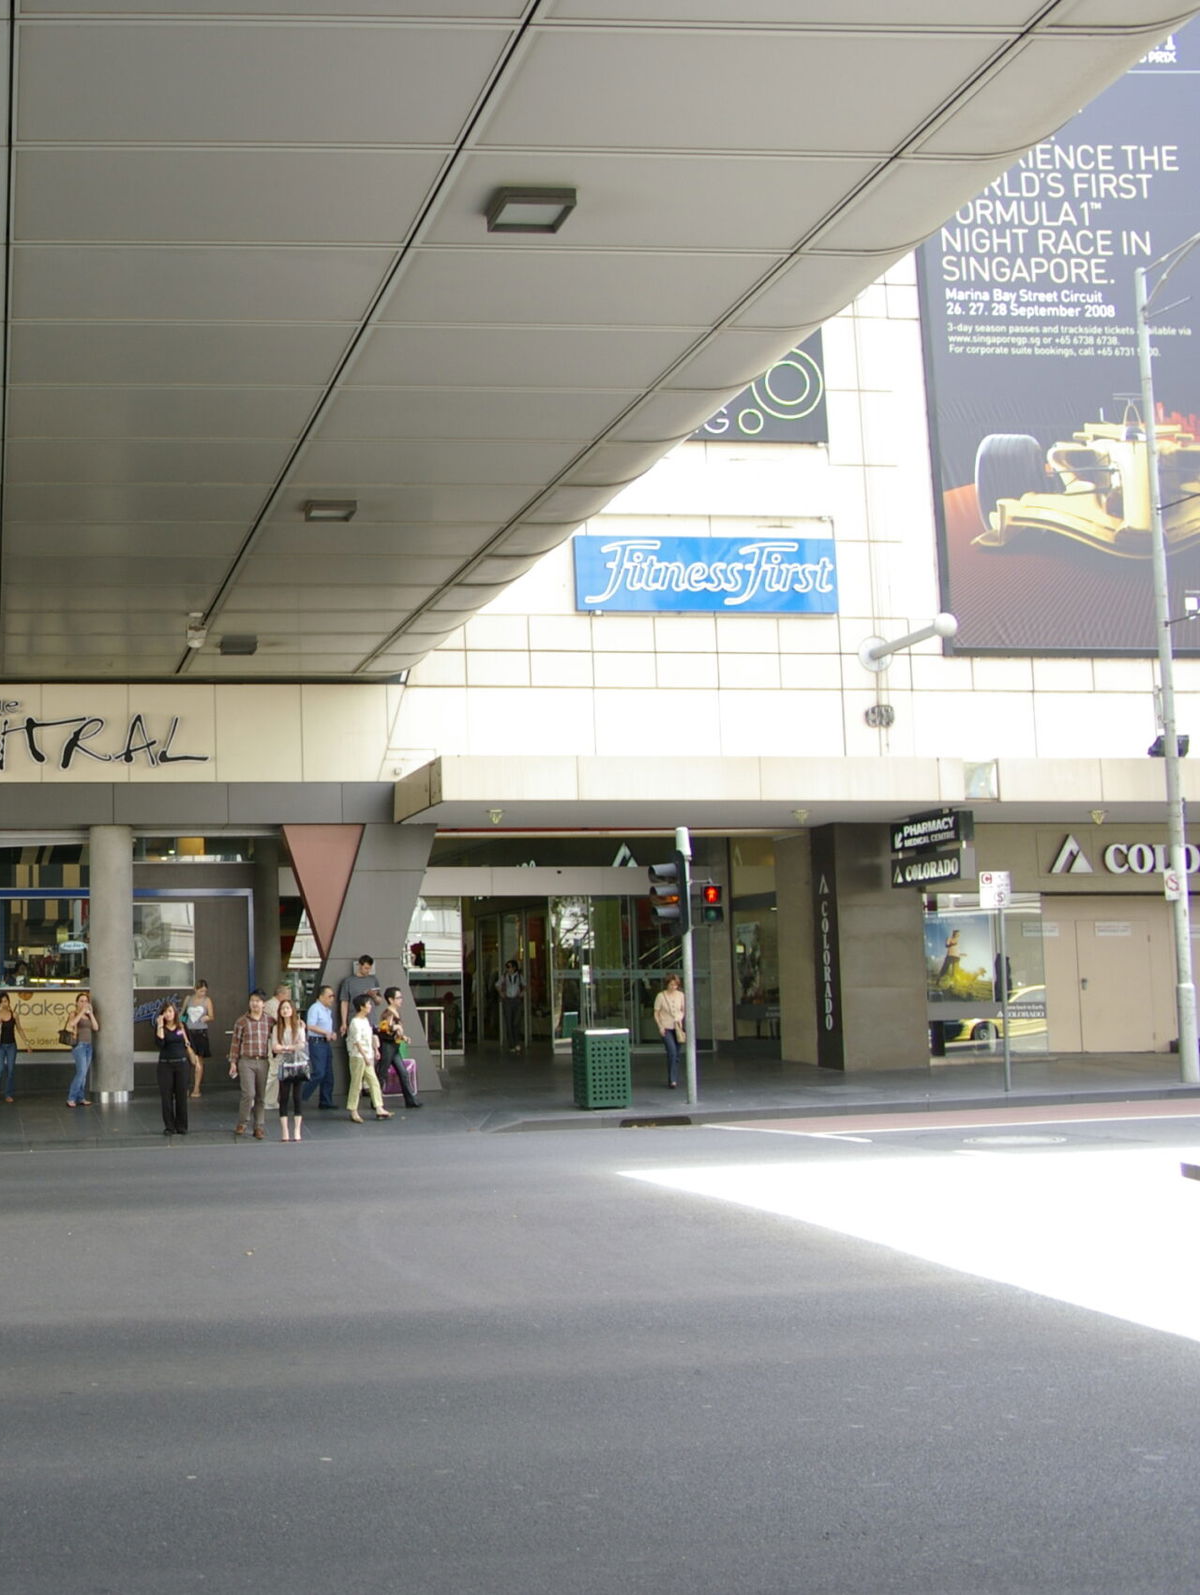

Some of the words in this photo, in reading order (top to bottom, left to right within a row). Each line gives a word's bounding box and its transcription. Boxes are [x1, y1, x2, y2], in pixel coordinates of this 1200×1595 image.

[1121, 145, 1180, 171] THE
[1073, 173, 1153, 199] FIRST
[941, 227, 1029, 254] NIGHT
[1038, 229, 1114, 256] RACE
[1122, 230, 1152, 256] IN
[942, 255, 1115, 284] SINGAPORE.
[945, 287, 990, 301] Marina
[993, 288, 1017, 304] Bay
[1019, 289, 1058, 302] Street
[1061, 290, 1103, 303] Circuit
[991, 303, 1008, 316] 28
[1010, 303, 1081, 319] September
[1084, 305, 1116, 318] 2008
[947, 322, 973, 333] 3-day
[975, 324, 1007, 333] season
[1008, 325, 1040, 335] passes
[1042, 325, 1059, 334] and
[1061, 325, 1103, 335] trackside
[1104, 326, 1135, 335] tickets
[1178, 327, 1193, 336] via
[948, 335, 1041, 346] www.singaporegp.sg
[1042, 337, 1053, 345] or
[1072, 336, 1094, 345] 6738
[949, 344, 964, 353] For
[966, 346, 1009, 356] corporate
[1011, 346, 1032, 355] suite
[1034, 346, 1077, 358] bookings,
[1078, 347, 1095, 356] call
[1114, 347, 1135, 356] 6731
[903, 815, 955, 838] PHARMACY
[903, 834, 930, 848] MEDICAL
[930, 829, 956, 842] CENTRE
[905, 857, 959, 882] COLORADO
[820, 900, 834, 1031] COLORADO
